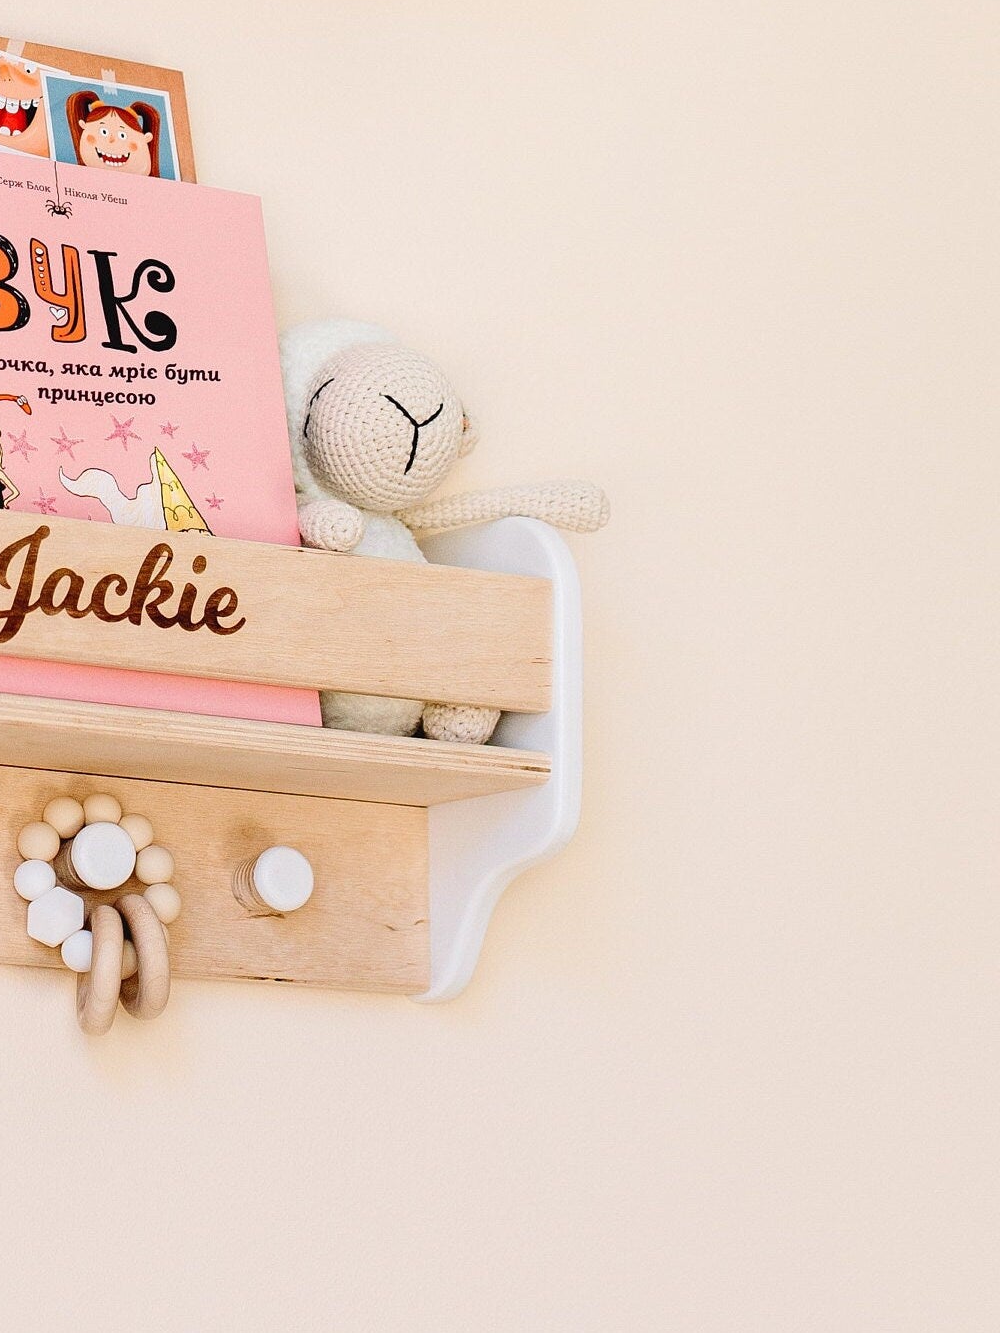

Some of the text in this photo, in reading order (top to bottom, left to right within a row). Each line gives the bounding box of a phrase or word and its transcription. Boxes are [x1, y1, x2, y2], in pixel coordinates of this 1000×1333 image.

[26, 180, 52, 194] Блок
[64, 186, 98, 202] Ніколя
[101, 192, 128, 206] Убеш
[60, 361, 103, 378] яка
[108, 363, 158, 383] мріє
[165, 362, 221, 385] бути
[37, 384, 156, 407] принцесою
